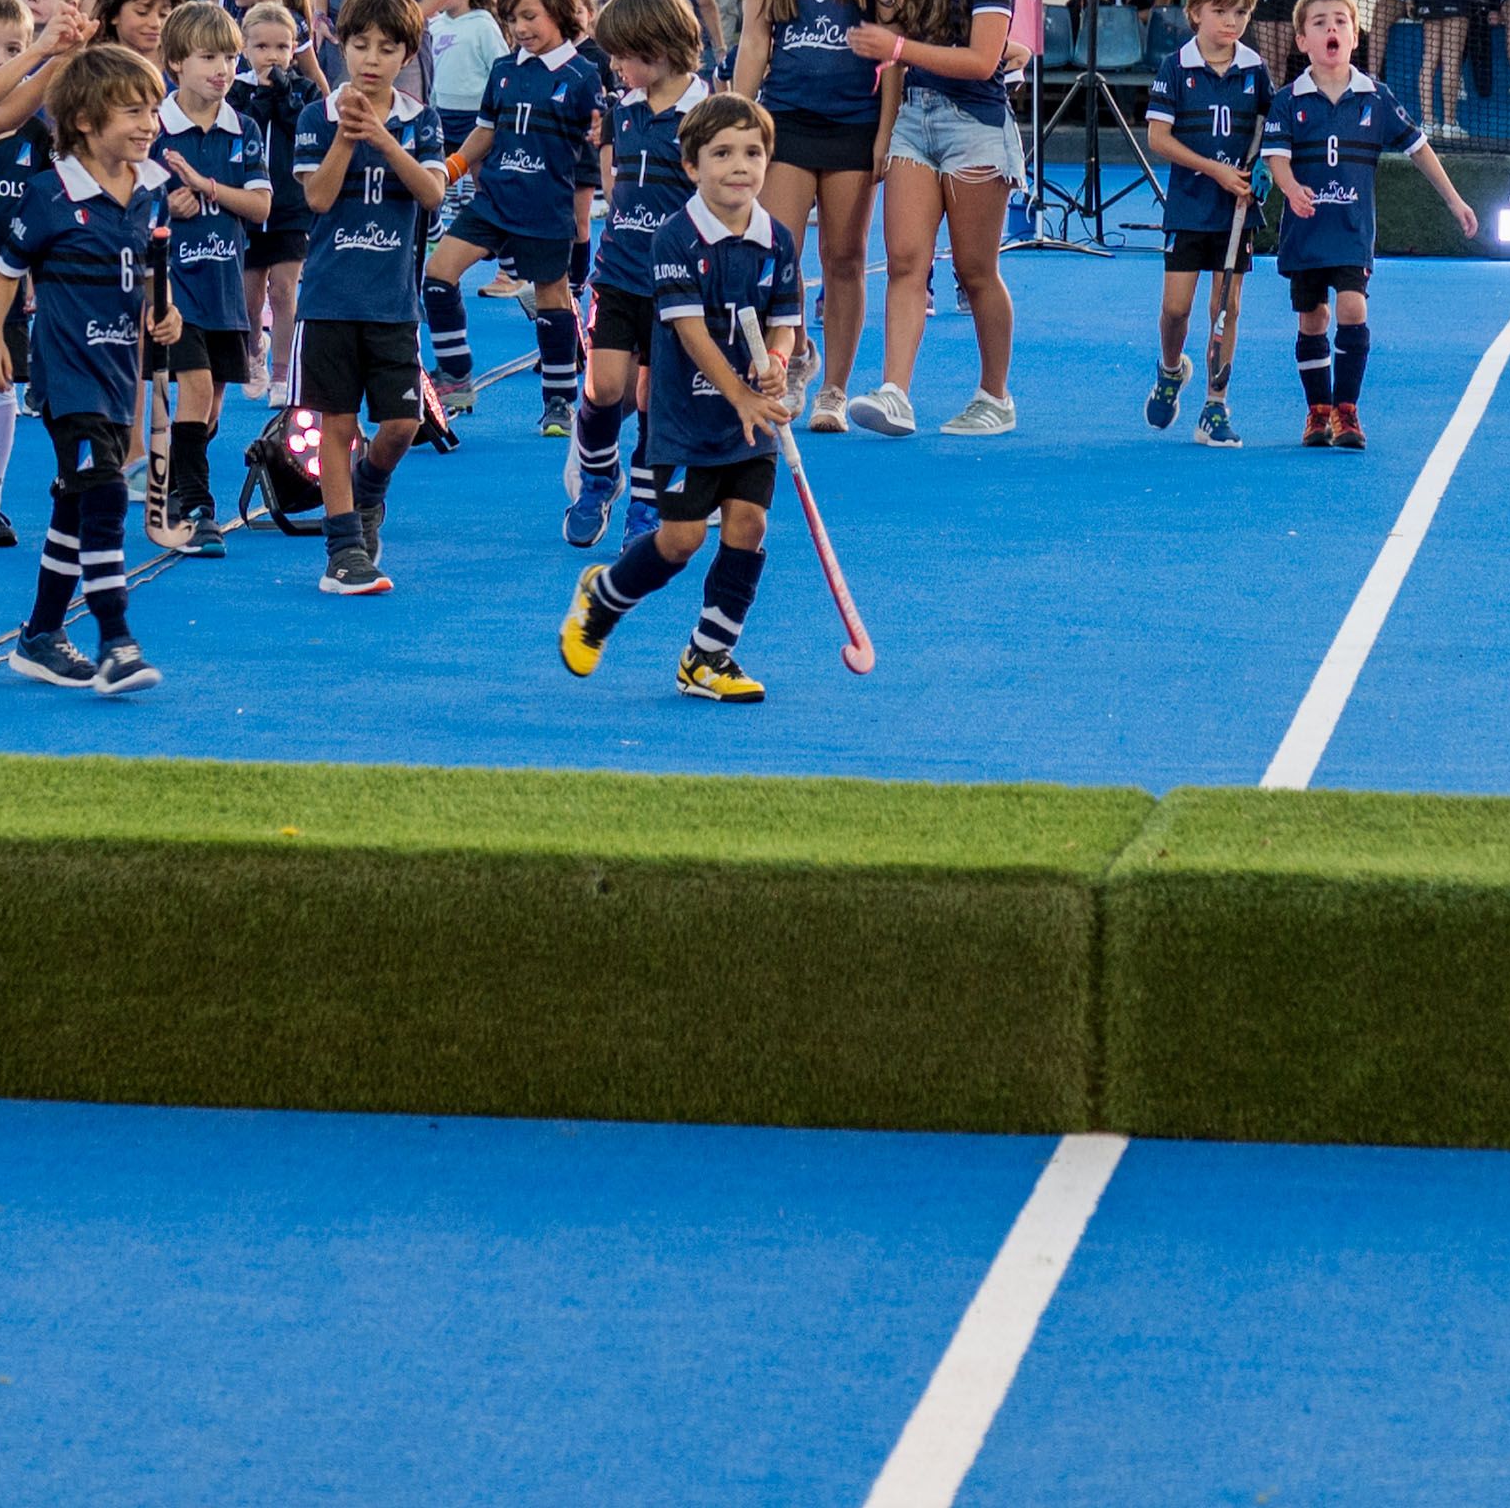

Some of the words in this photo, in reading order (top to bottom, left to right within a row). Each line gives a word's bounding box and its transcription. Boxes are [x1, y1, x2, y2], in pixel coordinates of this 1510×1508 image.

[515, 102, 532, 135] 17
[1208, 104, 1232, 137] 70
[1327, 134, 1339, 168] 6
[363, 166, 385, 205] 13
[120, 247, 134, 293] 6
[724, 302, 737, 346] 7
[149, 449, 168, 529] Dita
